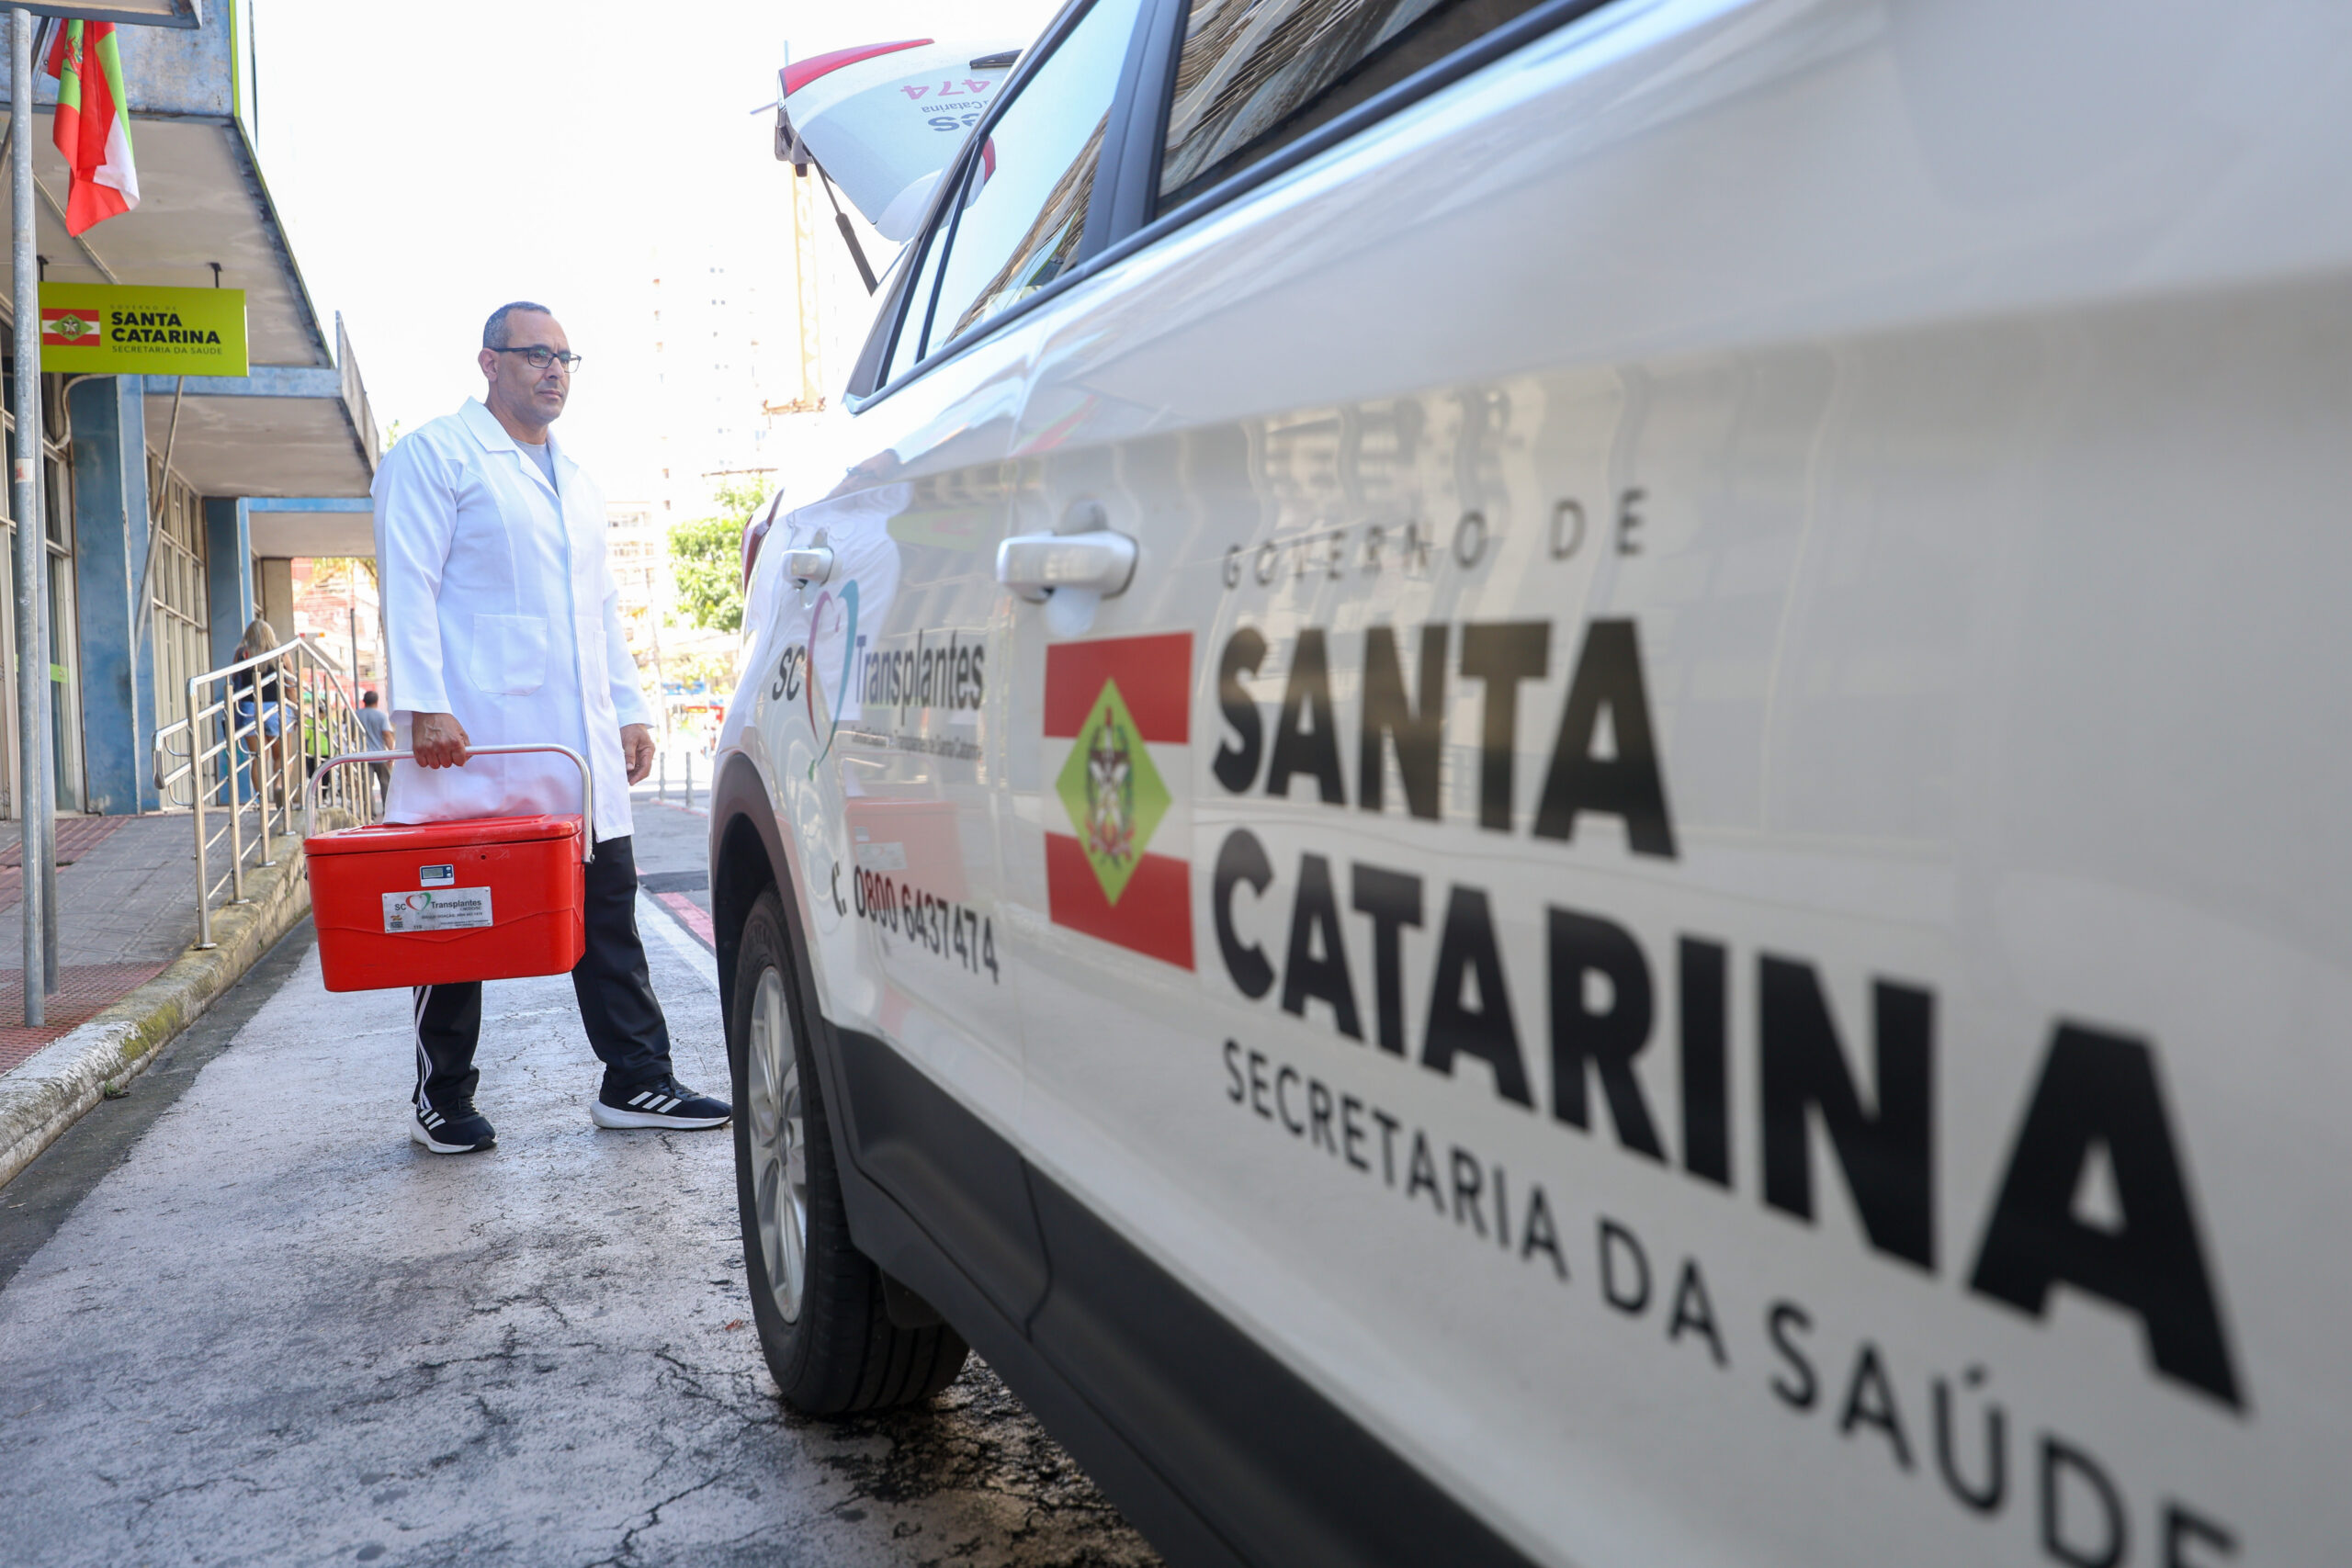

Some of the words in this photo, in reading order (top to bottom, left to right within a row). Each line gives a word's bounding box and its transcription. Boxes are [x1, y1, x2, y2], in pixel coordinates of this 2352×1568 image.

[921, 101, 983, 113] Catarina
[111, 311, 183, 327] SANTA
[111, 328, 221, 344] CATARINA
[112, 345, 171, 354] SECRETARIA
[174, 346, 187, 355] DA
[190, 345, 223, 355] SAÚDE
[1222, 510, 1488, 590] GOVERNO
[1549, 487, 1647, 562] DE
[772, 645, 806, 701] SC
[855, 628, 986, 727] Transplantes
[1211, 615, 1682, 863] SANTA
[394, 903, 407, 911] SC
[431, 899, 482, 910] Transplantes
[854, 864, 899, 933] 0800
[901, 883, 1000, 985] 6437474
[1213, 826, 2252, 1421] CATARINA
[1223, 1037, 1570, 1283] SECRETARIA
[1596, 1213, 1731, 1371] DA
